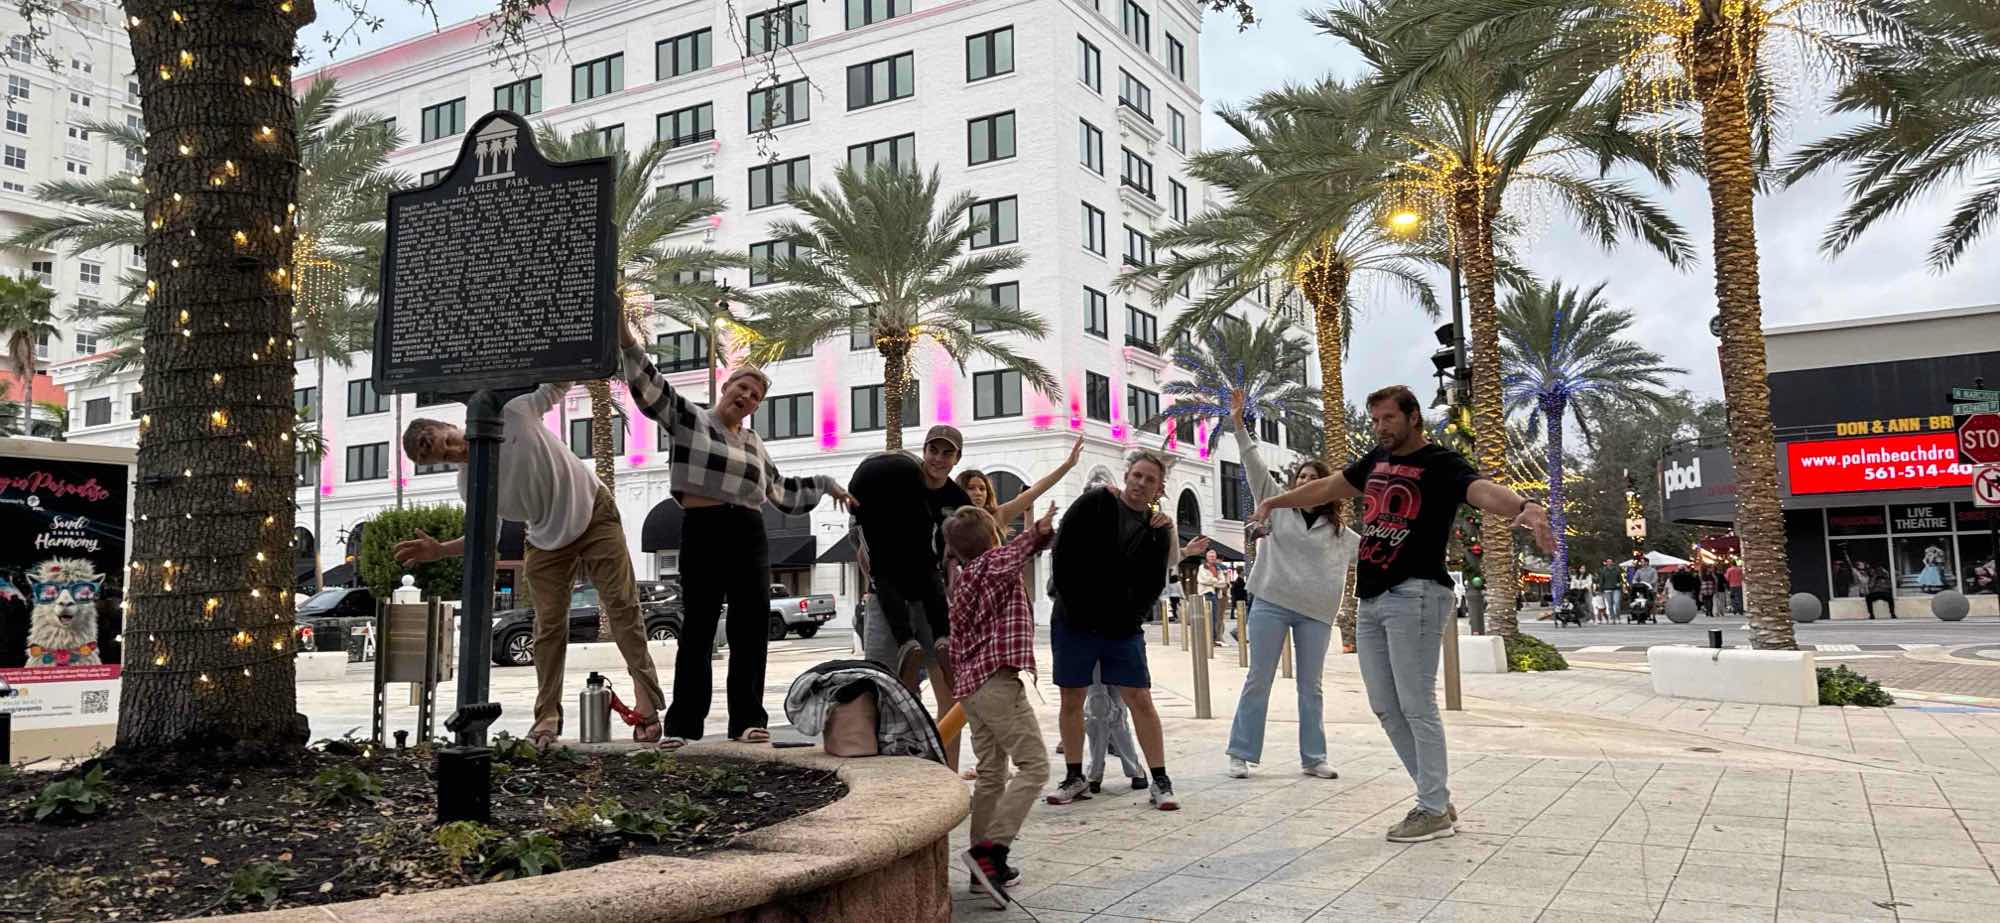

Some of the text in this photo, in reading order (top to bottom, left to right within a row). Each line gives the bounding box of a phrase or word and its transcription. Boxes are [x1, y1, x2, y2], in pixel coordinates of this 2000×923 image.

[458, 177, 530, 196] FLAGLER PARK
[1836, 421, 1869, 436] DON
[1871, 419, 1884, 434] &
[1888, 417, 1920, 432] ANN
[1964, 428, 1999, 449] STO
[1801, 444, 1955, 468] www.palmbeachdra
[1664, 457, 1702, 499] pbd
[1864, 463, 1972, 480] 561-514-40
[1907, 507, 1933, 517] LIVE
[1895, 517, 1947, 529] THEATRE
[34, 532, 102, 553] Harmony
